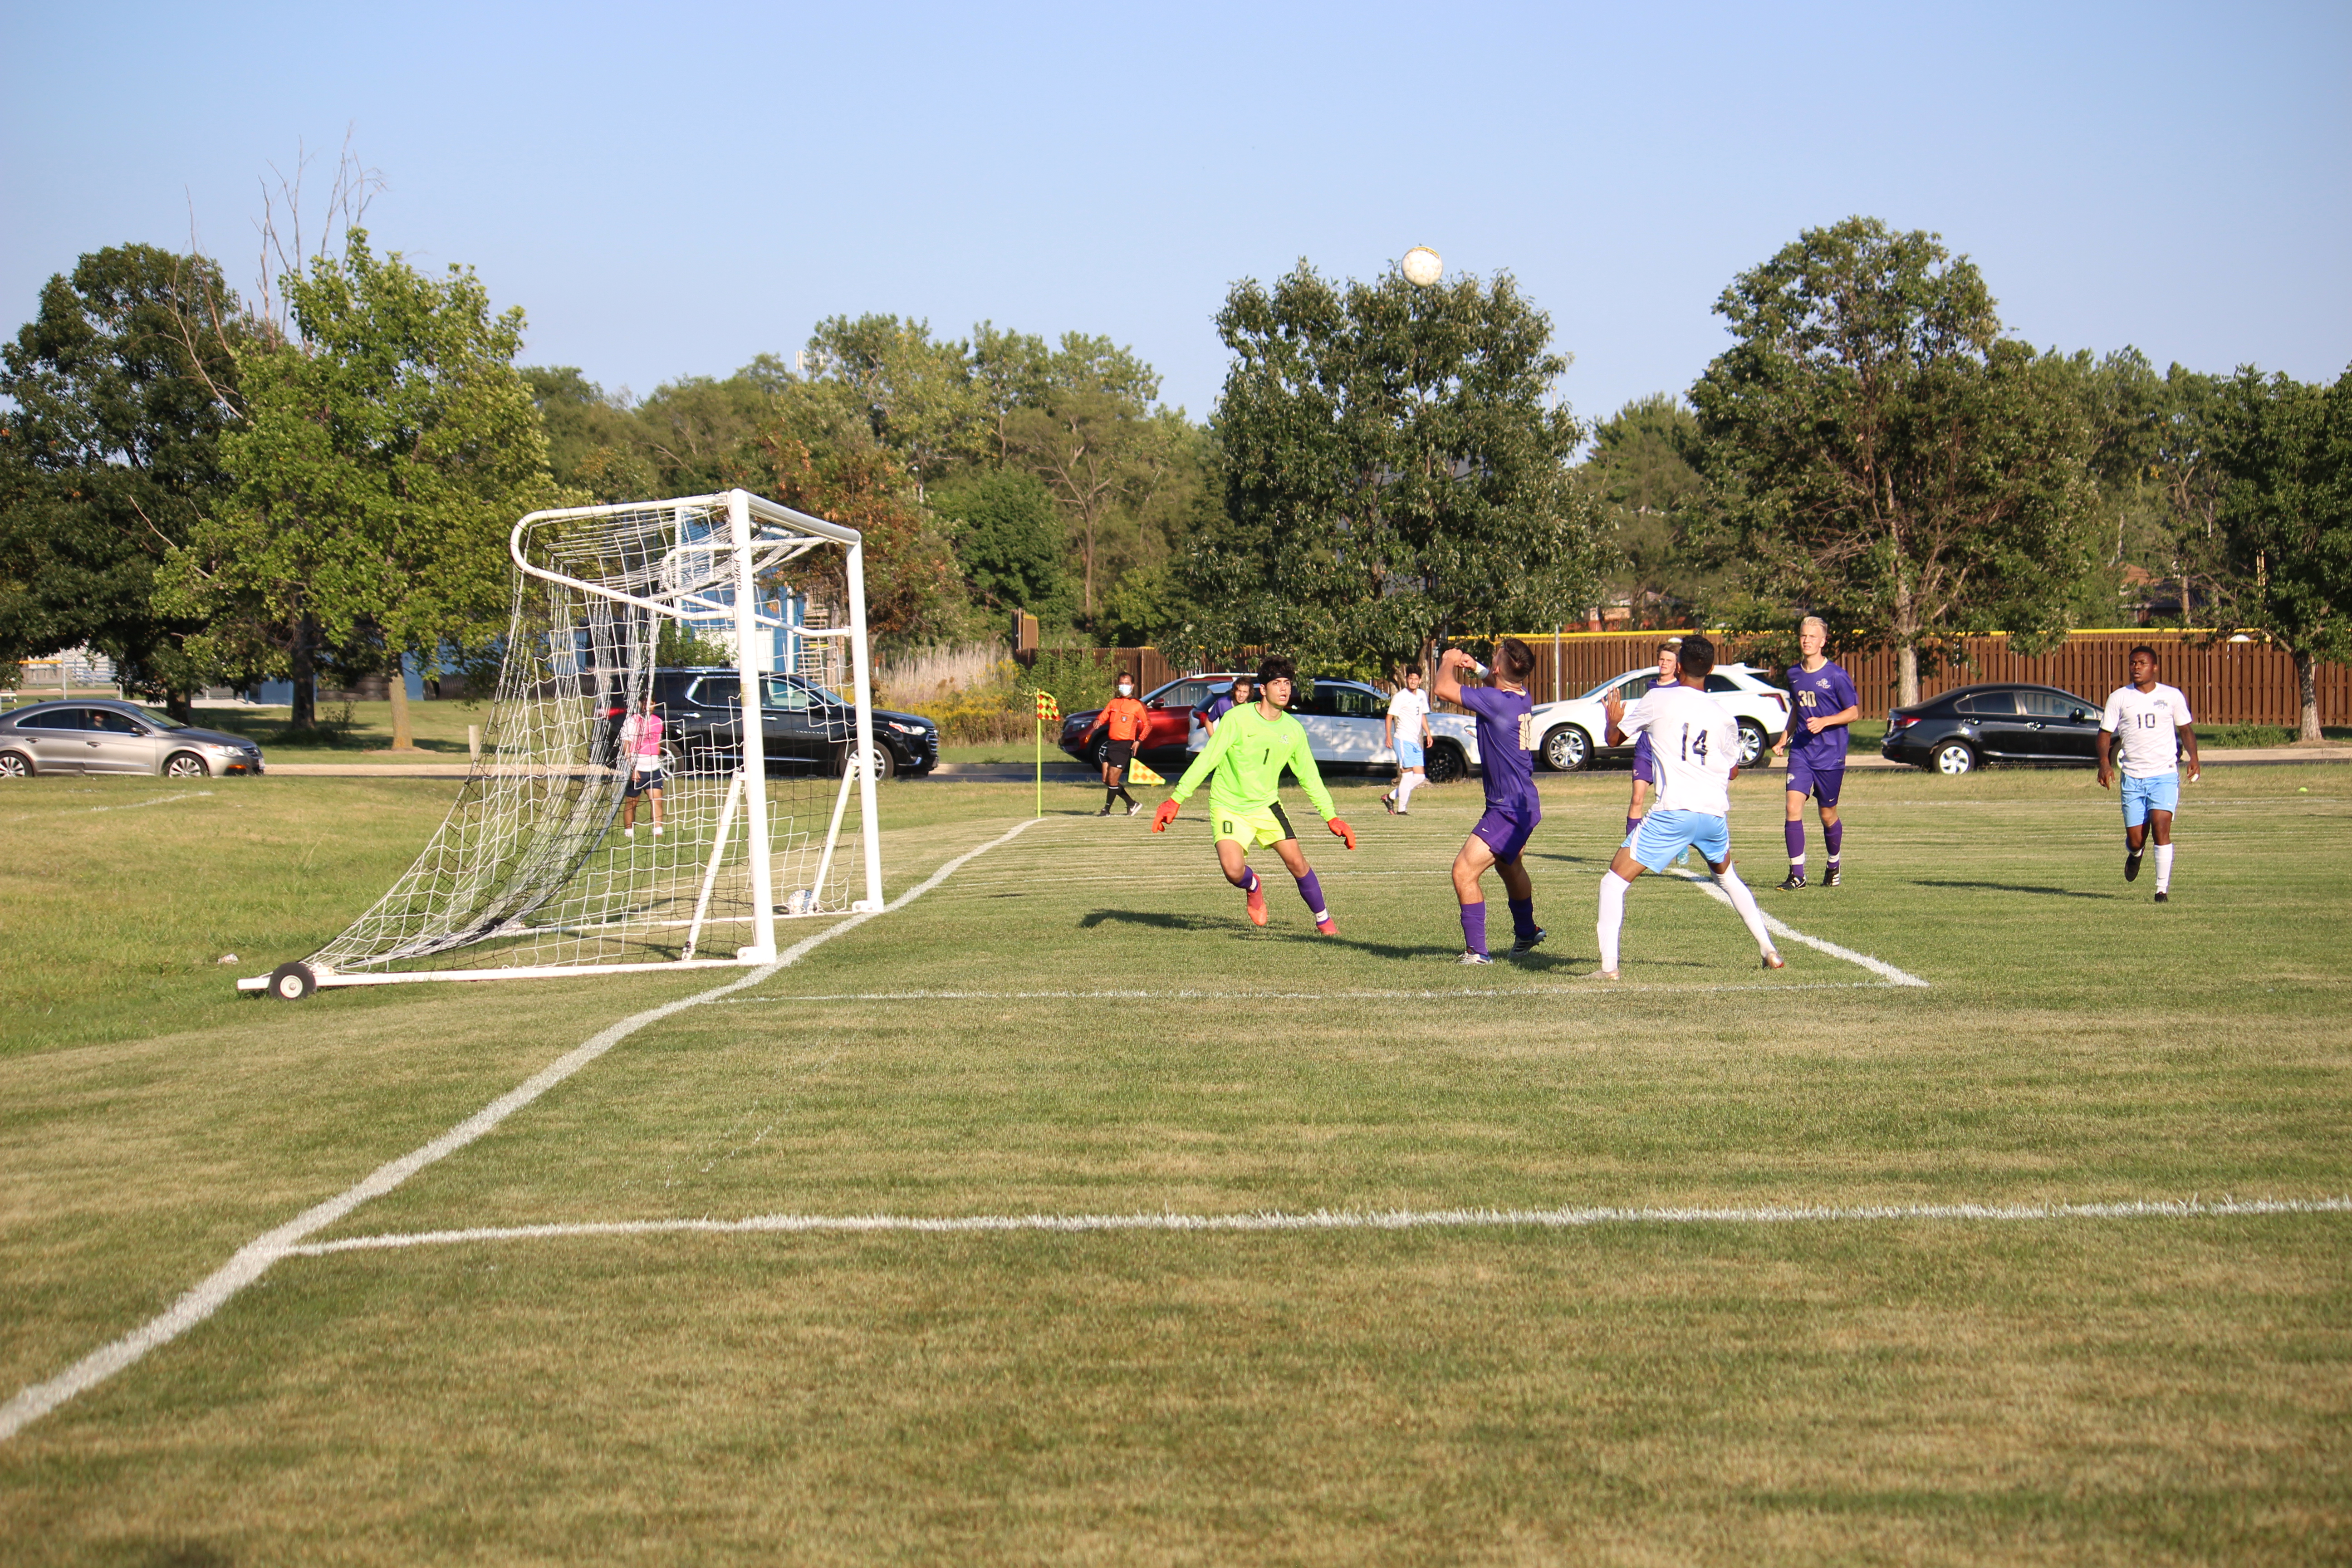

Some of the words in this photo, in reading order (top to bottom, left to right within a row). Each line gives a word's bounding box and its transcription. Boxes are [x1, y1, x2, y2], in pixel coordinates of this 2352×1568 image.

[733, 559, 742, 590] jaypro
[1798, 690, 1817, 707] 30
[1416, 706, 1419, 715] 3
[2136, 713, 2155, 729] 10
[1681, 722, 1708, 765] 14
[1263, 748, 1269, 765] 1
[1222, 820, 1233, 834] 0
